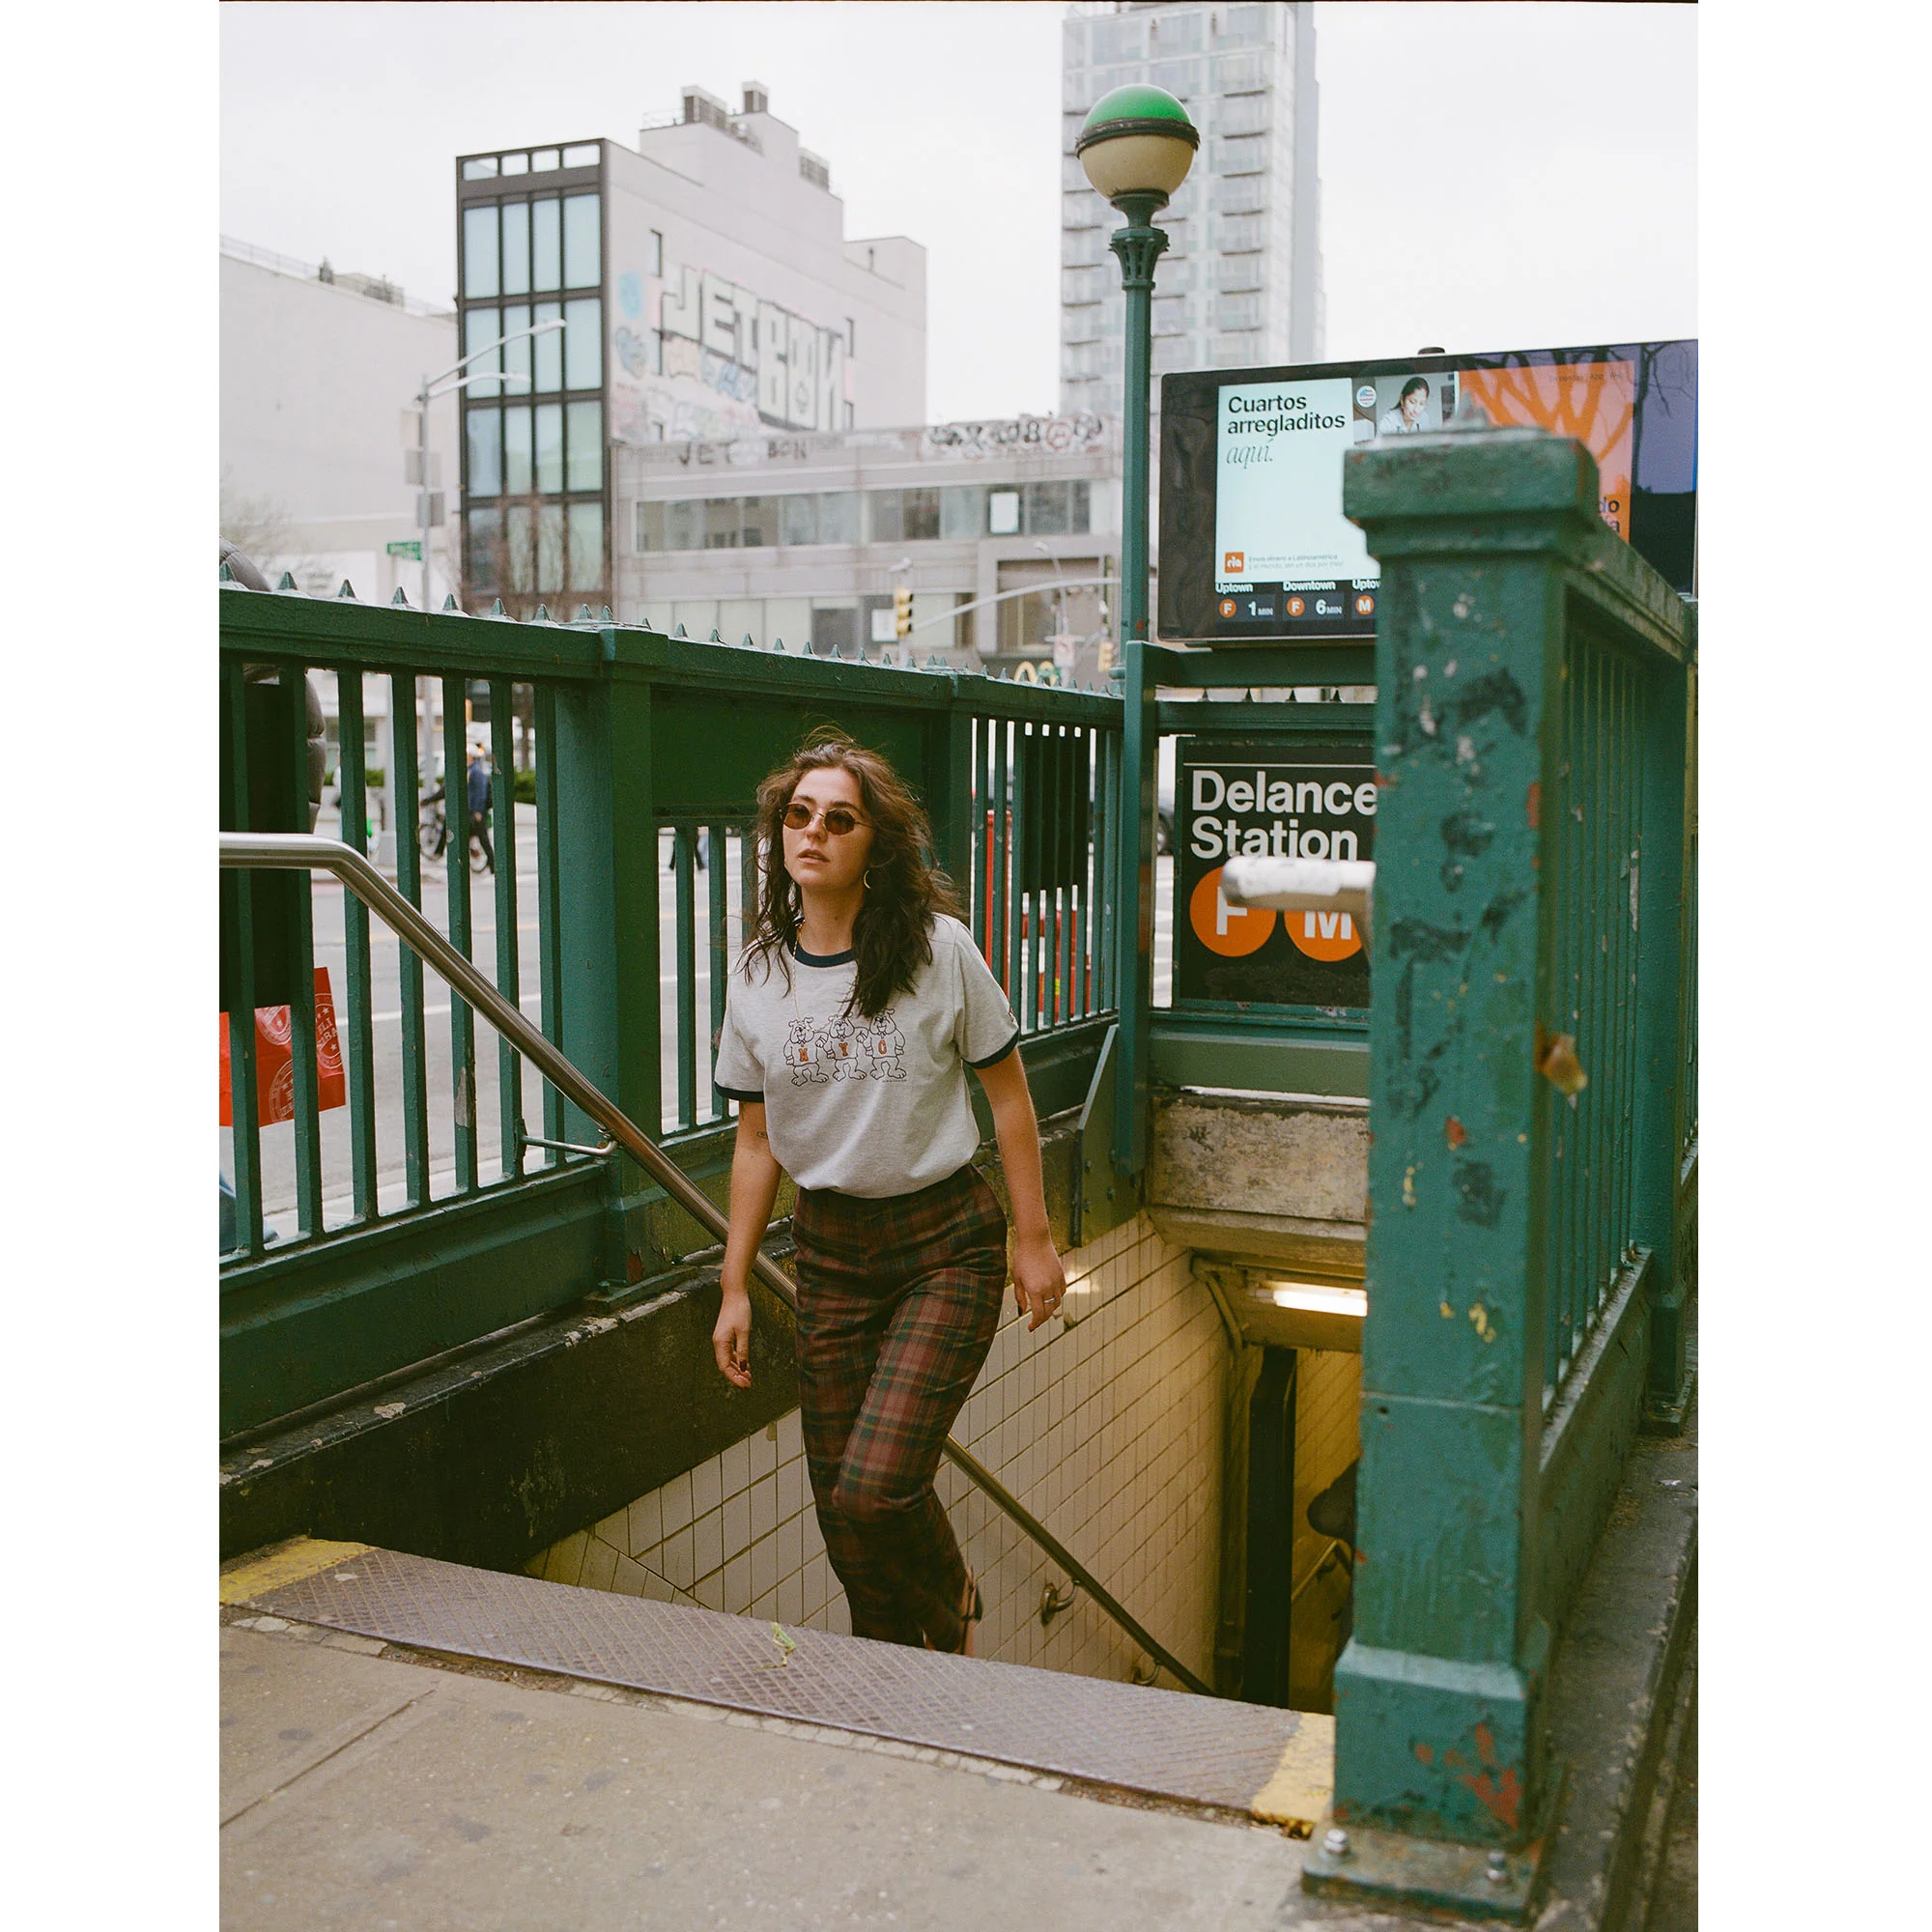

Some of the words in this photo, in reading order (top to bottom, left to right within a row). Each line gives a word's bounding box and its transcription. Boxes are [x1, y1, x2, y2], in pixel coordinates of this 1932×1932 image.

[1228, 395, 1307, 413] Cuartos
[1228, 412, 1346, 437] arregladitos
[1216, 582, 1254, 595] Uptown
[1283, 581, 1336, 591] Downtown
[1352, 579, 1380, 591] Upto
[1224, 602, 1233, 615] F
[1248, 601, 1256, 616] 1
[1258, 608, 1274, 616] MIN
[1292, 601, 1301, 613] F
[1316, 599, 1327, 615] 6
[1326, 606, 1343, 614] MIN
[1358, 599, 1371, 611] M
[1192, 770, 1378, 815] Delance
[1190, 816, 1358, 862] Station
[838, 1042, 848, 1057] Y
[878, 1039, 888, 1055] C
